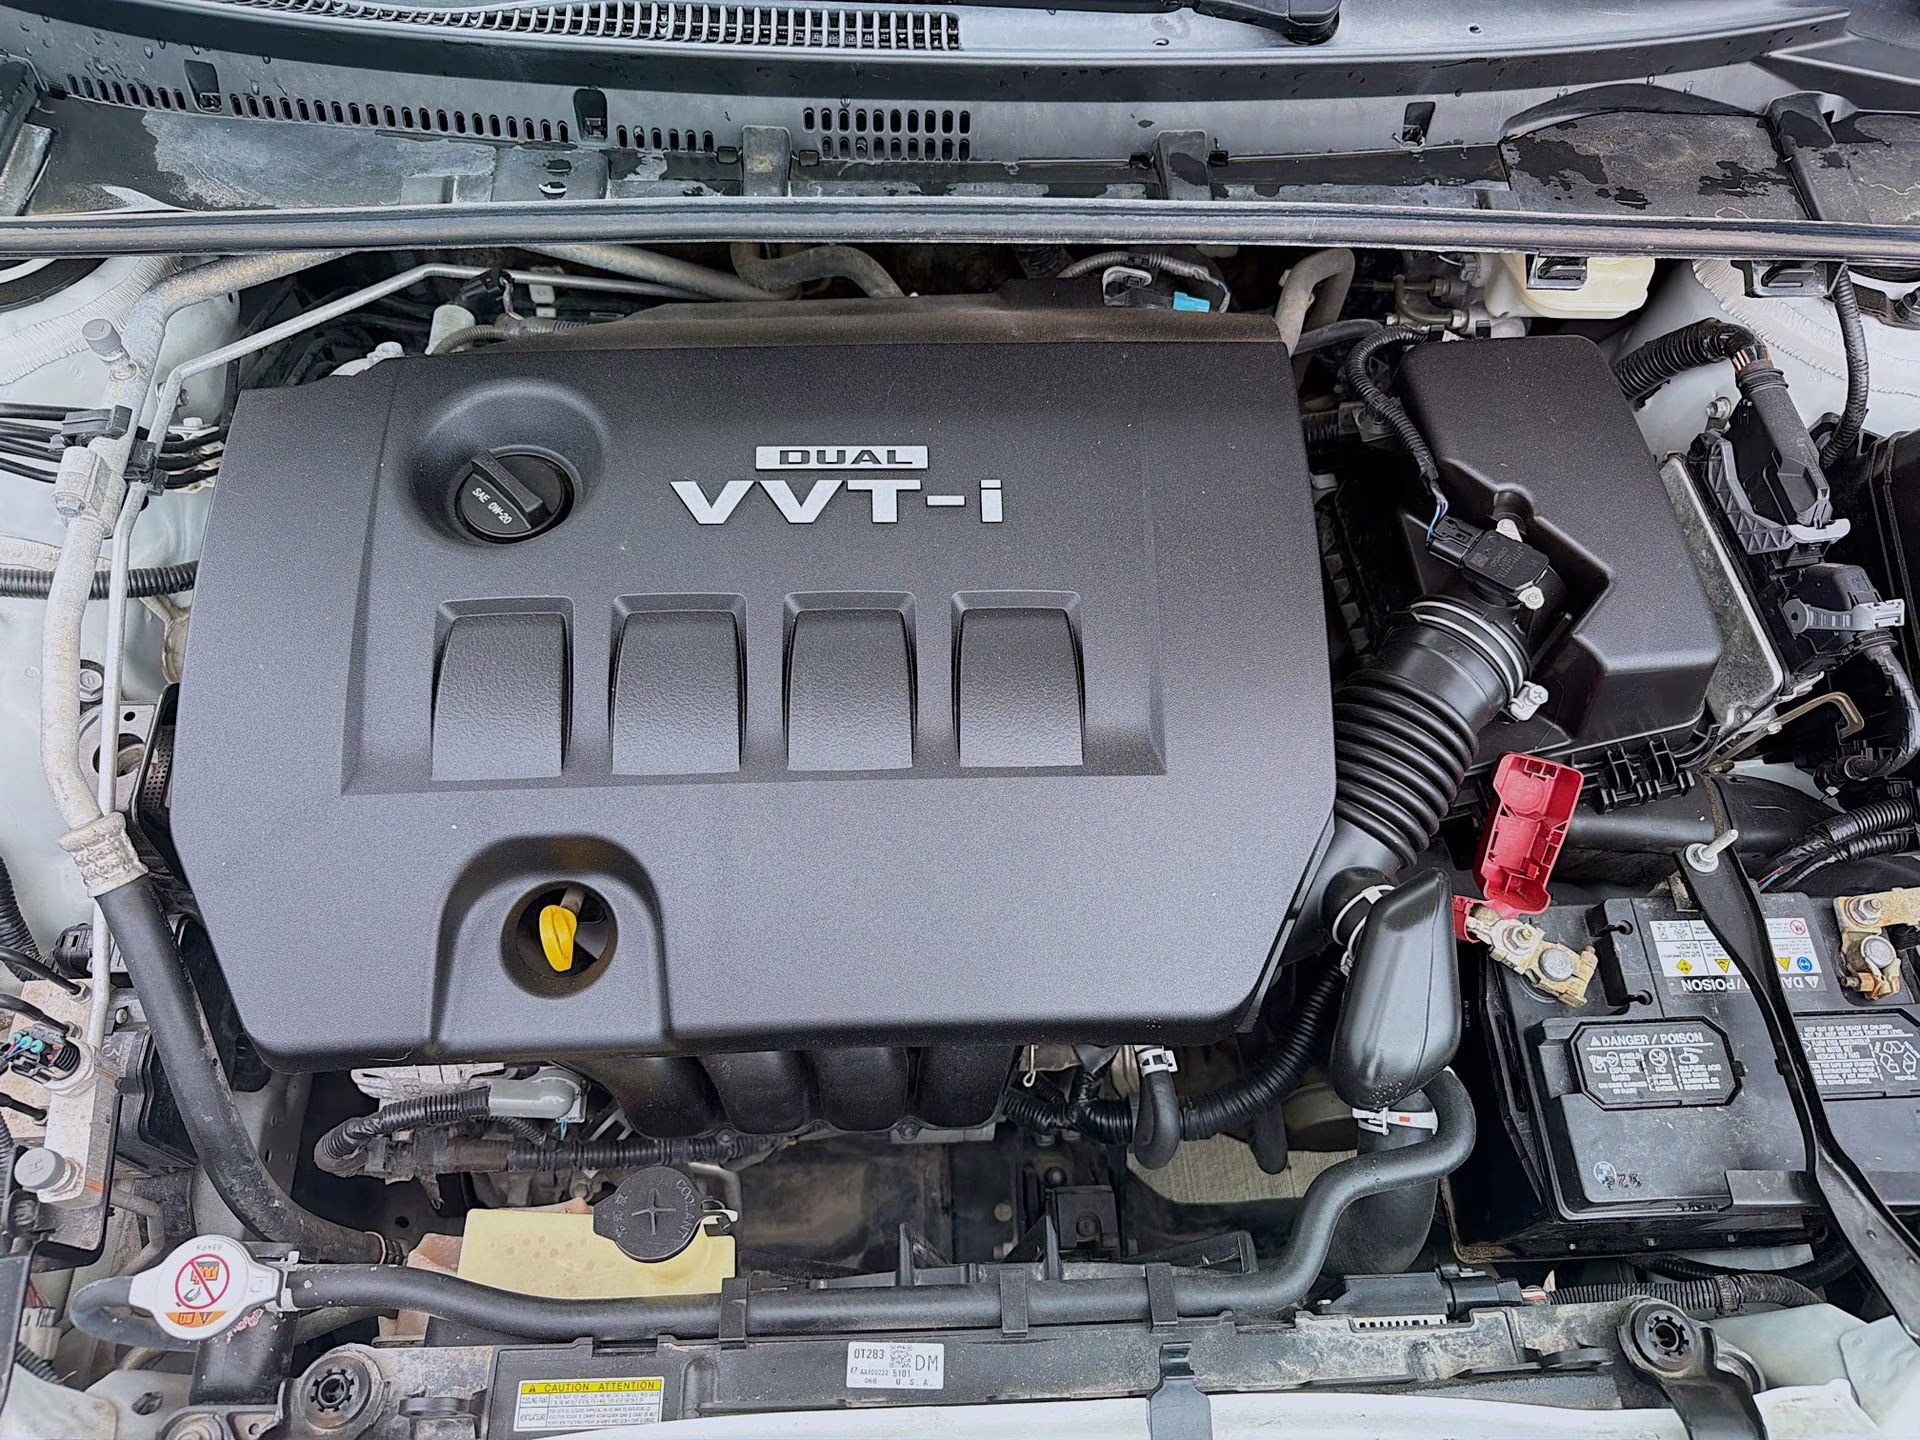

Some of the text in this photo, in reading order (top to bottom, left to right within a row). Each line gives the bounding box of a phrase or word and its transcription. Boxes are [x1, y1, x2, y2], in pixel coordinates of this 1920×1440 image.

[779, 449, 913, 465] DUAL
[472, 487, 513, 525] SAE 0W-20
[670, 479, 1003, 524] VVT-i
[1681, 977, 1735, 993] POISON
[1600, 1032, 1704, 1047] DANGER / POISON
[676, 1180, 695, 1239] COOLANT
[915, 1354, 938, 1371] DM
[544, 1381, 654, 1393] CAUTION ATTENTION
